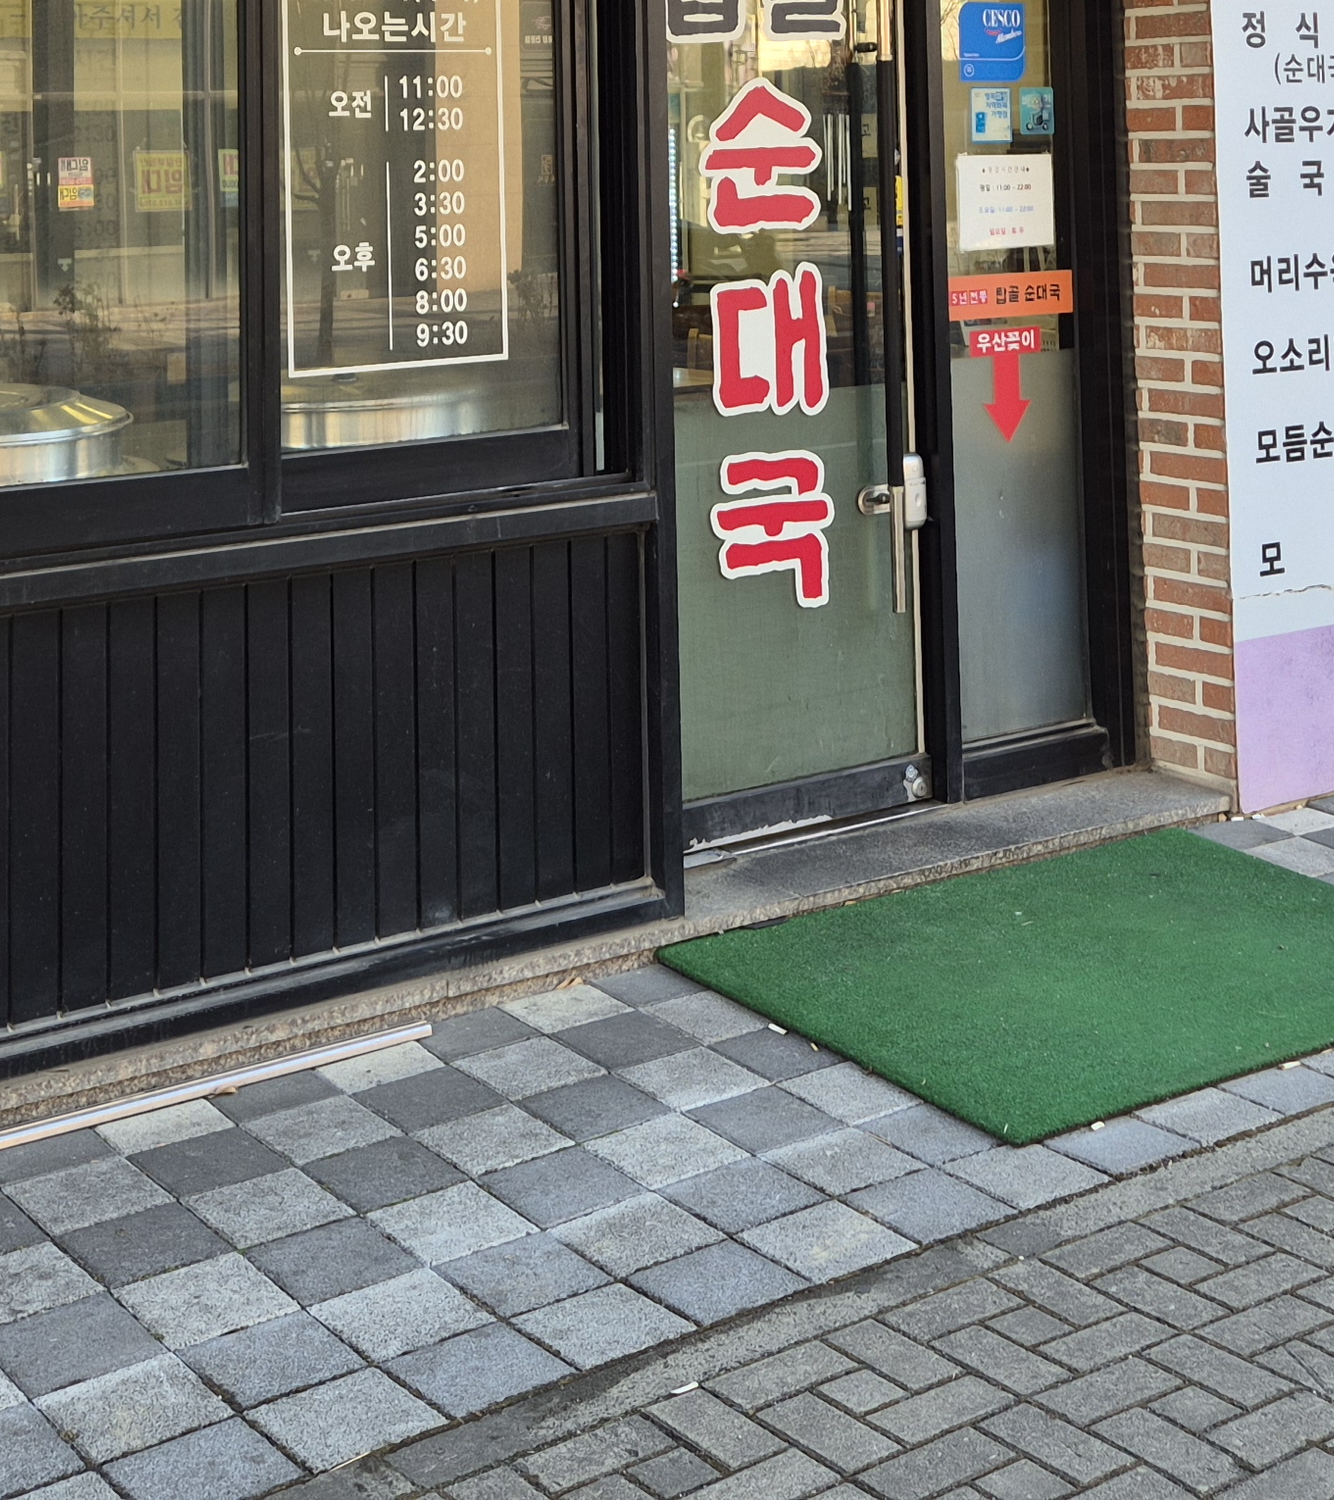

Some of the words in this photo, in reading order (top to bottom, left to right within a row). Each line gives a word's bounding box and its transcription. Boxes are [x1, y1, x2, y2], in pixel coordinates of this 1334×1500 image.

[982, 8, 1021, 27] CESCO
[328, 89, 372, 119] 오전
[399, 75, 463, 99] 11:00
[400, 107, 464, 132] 12:30
[413, 159, 465, 183] 2:00
[414, 191, 465, 216] 3:30
[414, 223, 466, 248] 5:00
[331, 241, 376, 272] 오후
[415, 256, 467, 281] 6:30
[416, 288, 468, 315] 8:00
[1024, 283, 1061, 302] 순대국
[416, 320, 468, 347] 9:30
[704, 84, 831, 602] 순대국
